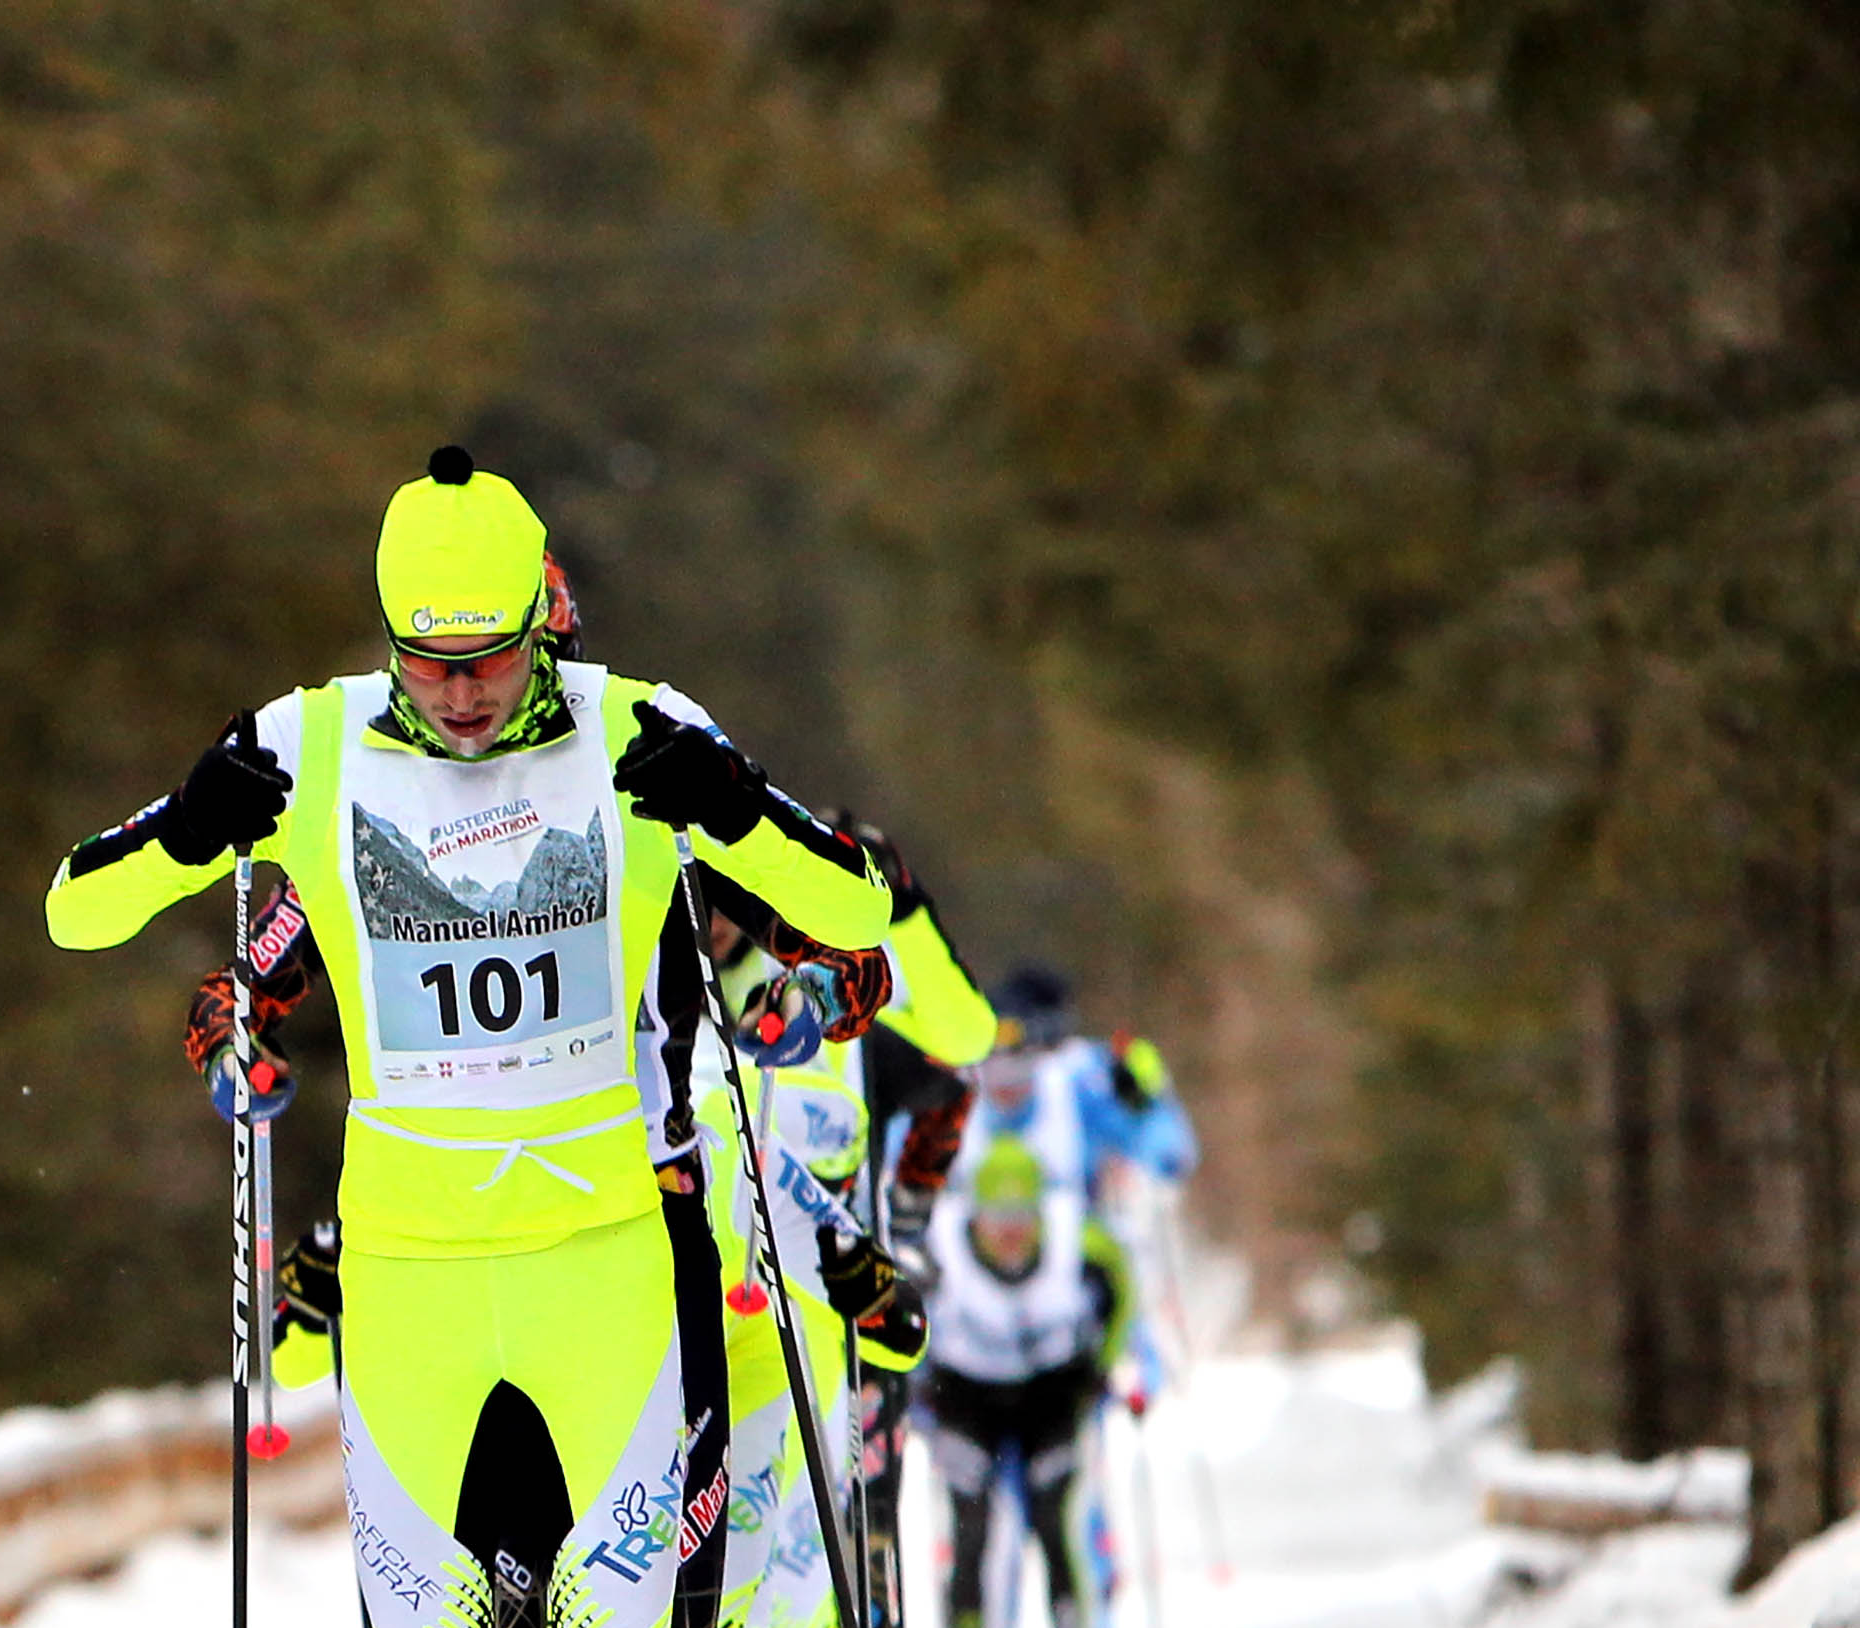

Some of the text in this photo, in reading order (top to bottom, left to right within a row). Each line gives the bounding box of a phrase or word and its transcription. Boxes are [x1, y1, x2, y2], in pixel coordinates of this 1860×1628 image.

[434, 615, 498, 625] FUTURA
[428, 811, 540, 861] SKI-MARATHON
[393, 896, 597, 943] Manuel Amhof
[420, 951, 561, 1036] 101
[582, 1448, 688, 1584] TRENT
[688, 1467, 729, 1537] Max
[350, 1511, 423, 1612] TURA
